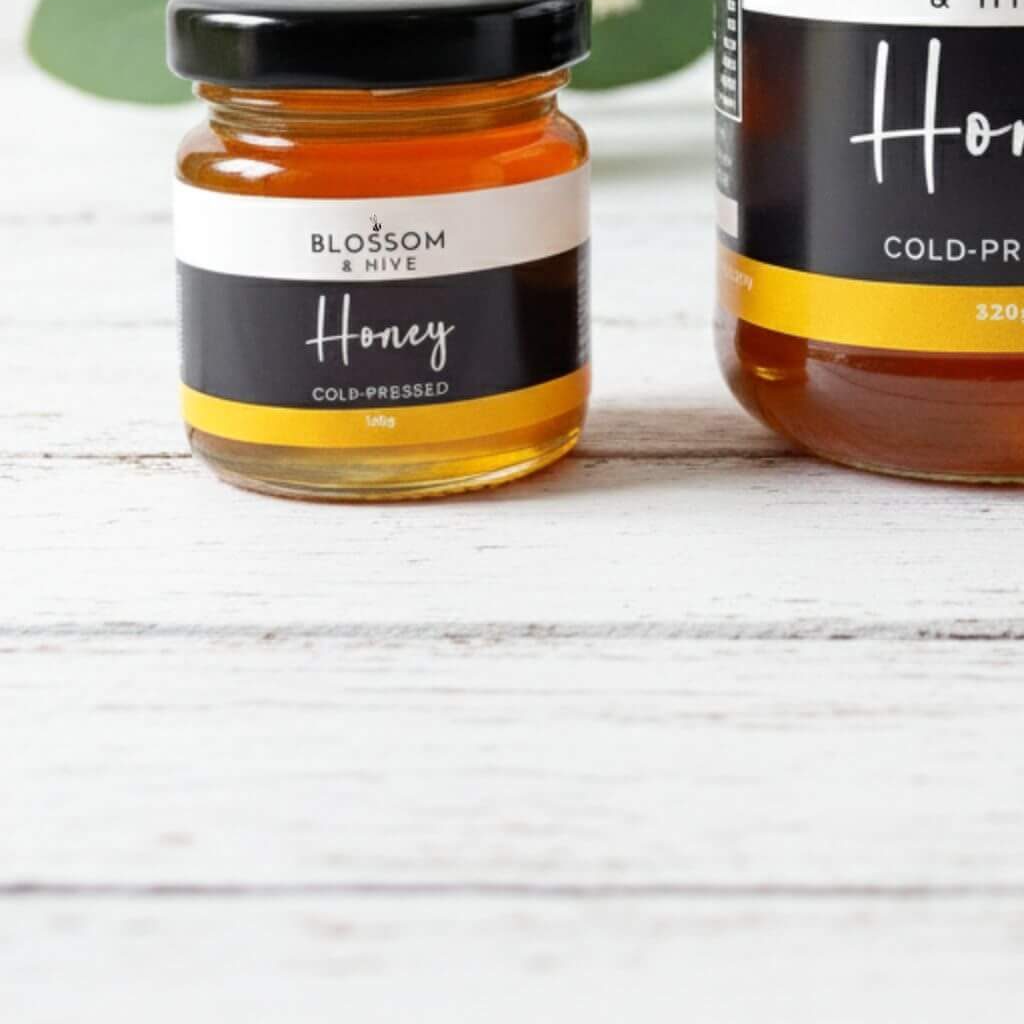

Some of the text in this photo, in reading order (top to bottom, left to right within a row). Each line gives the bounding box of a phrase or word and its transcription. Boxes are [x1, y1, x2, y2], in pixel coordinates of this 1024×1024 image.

[310, 229, 447, 255] BLOSSOM
[340, 256, 418, 274] & HIVE
[305, 293, 456, 372] Honey
[311, 381, 450, 403] COLD-PRESSED
